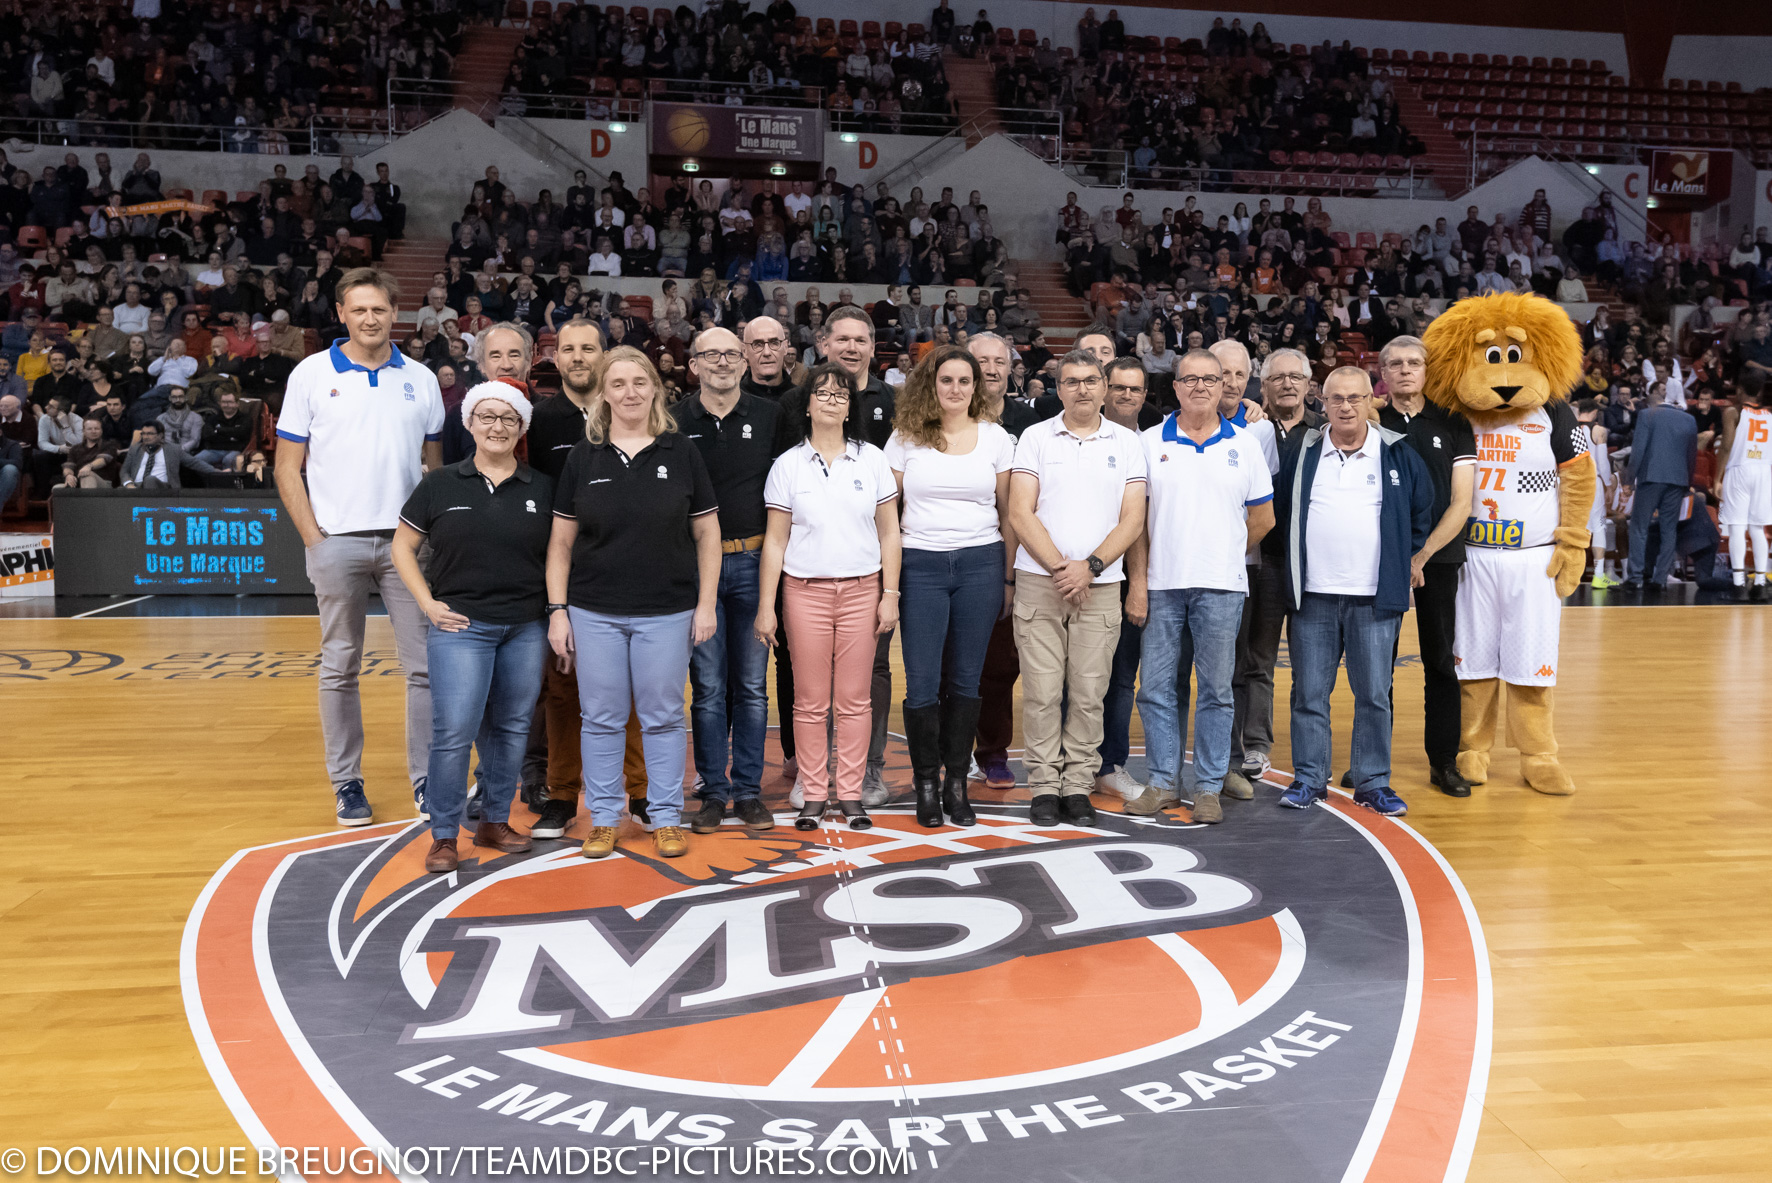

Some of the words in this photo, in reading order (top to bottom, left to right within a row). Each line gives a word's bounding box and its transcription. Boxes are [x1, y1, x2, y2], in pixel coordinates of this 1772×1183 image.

[741, 118, 756, 134] Le
[760, 119, 797, 136] Mans
[590, 129, 611, 158] D
[741, 136, 760, 148] Une
[762, 137, 797, 155] Marque
[858, 141, 878, 169] D
[1624, 172, 1639, 199] C
[1654, 180, 1668, 192] Le
[1671, 180, 1704, 193] Mans
[1482, 433, 1522, 450] MANS
[1747, 418, 1768, 443] 15
[1476, 449, 1517, 463] ARTHE
[1478, 467, 1507, 491] 72
[145, 517, 176, 546] Le
[186, 516, 264, 546] Mans
[1470, 518, 1521, 546] oué
[146, 553, 184, 573] Une
[190, 553, 265, 585] Marque
[412, 842, 1255, 1040] MSB
[394, 1054, 501, 1099] LE
[477, 1083, 736, 1147] MANS
[752, 1095, 1125, 1150] SARTHE
[1120, 1010, 1353, 1113] BASKET
